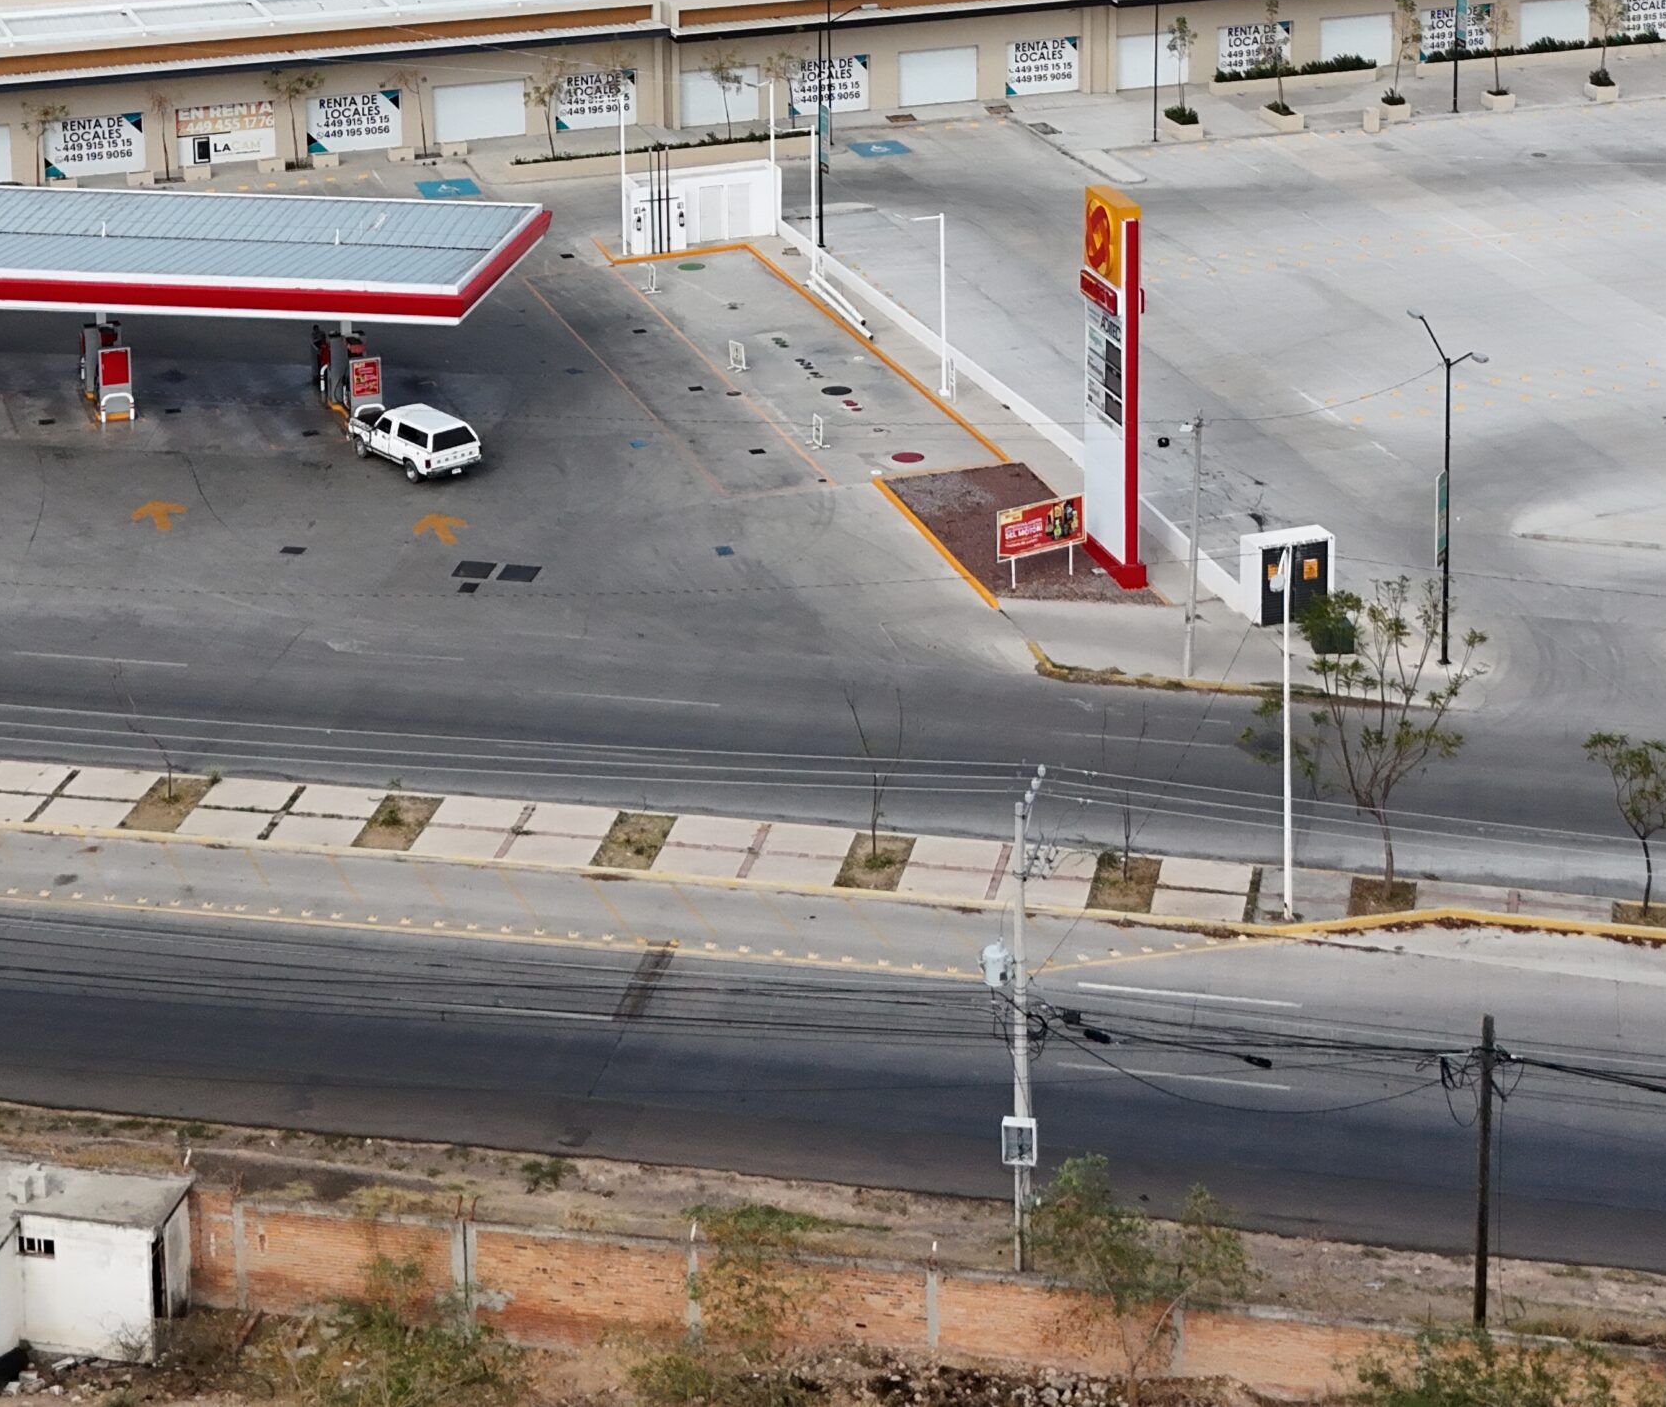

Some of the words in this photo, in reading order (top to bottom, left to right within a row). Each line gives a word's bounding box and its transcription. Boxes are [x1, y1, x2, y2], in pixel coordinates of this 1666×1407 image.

[1228, 26, 1260, 37] RENTA
[1264, 24, 1276, 34] DE
[1015, 41, 1048, 52] RENTA
[1053, 39, 1065, 49] DE
[1229, 35, 1275, 47] LOCALES
[1468, 37, 1484, 46] 056
[1015, 50, 1062, 63] LOCALES
[801, 60, 835, 72] RENTA
[839, 58, 852, 68] DE
[1015, 65, 1031, 73] 449
[1034, 64, 1048, 72] 915
[567, 74, 602, 86] RENTA
[606, 74, 621, 83] DE
[802, 69, 851, 82] LOCALES
[1016, 75, 1032, 83] 449
[1050, 72, 1072, 81] 9056
[800, 85, 817, 93] 449
[838, 82, 847, 90] 15
[319, 96, 357, 109] RENTA
[362, 95, 377, 105] DE
[801, 95, 817, 103] 449
[837, 91, 860, 100] 9056
[178, 107, 204, 120] EN
[209, 102, 272, 118] RENTA
[325, 106, 380, 119] LOCALES
[588, 105, 603, 114] 195
[606, 104, 629, 112] 906
[62, 119, 102, 132] RENTA
[107, 117, 123, 128] DE
[186, 121, 212, 134] 449
[215, 118, 240, 131] 455
[243, 115, 274, 129] 1776
[324, 118, 343, 127] 449
[346, 117, 362, 125] 915
[367, 116, 376, 124] 15
[380, 115, 389, 123] 15
[63, 129, 122, 143] LOCALES
[324, 129, 343, 138] 449
[346, 128, 362, 136] 195
[365, 126, 389, 135] 9056
[62, 143, 83, 152] 449
[86, 141, 103, 150] 915
[107, 139, 118, 148] 15
[122, 138, 132, 147] 15
[64, 154, 83, 162] 449
[86, 152, 103, 161] 195
[106, 149, 132, 159] 9056
